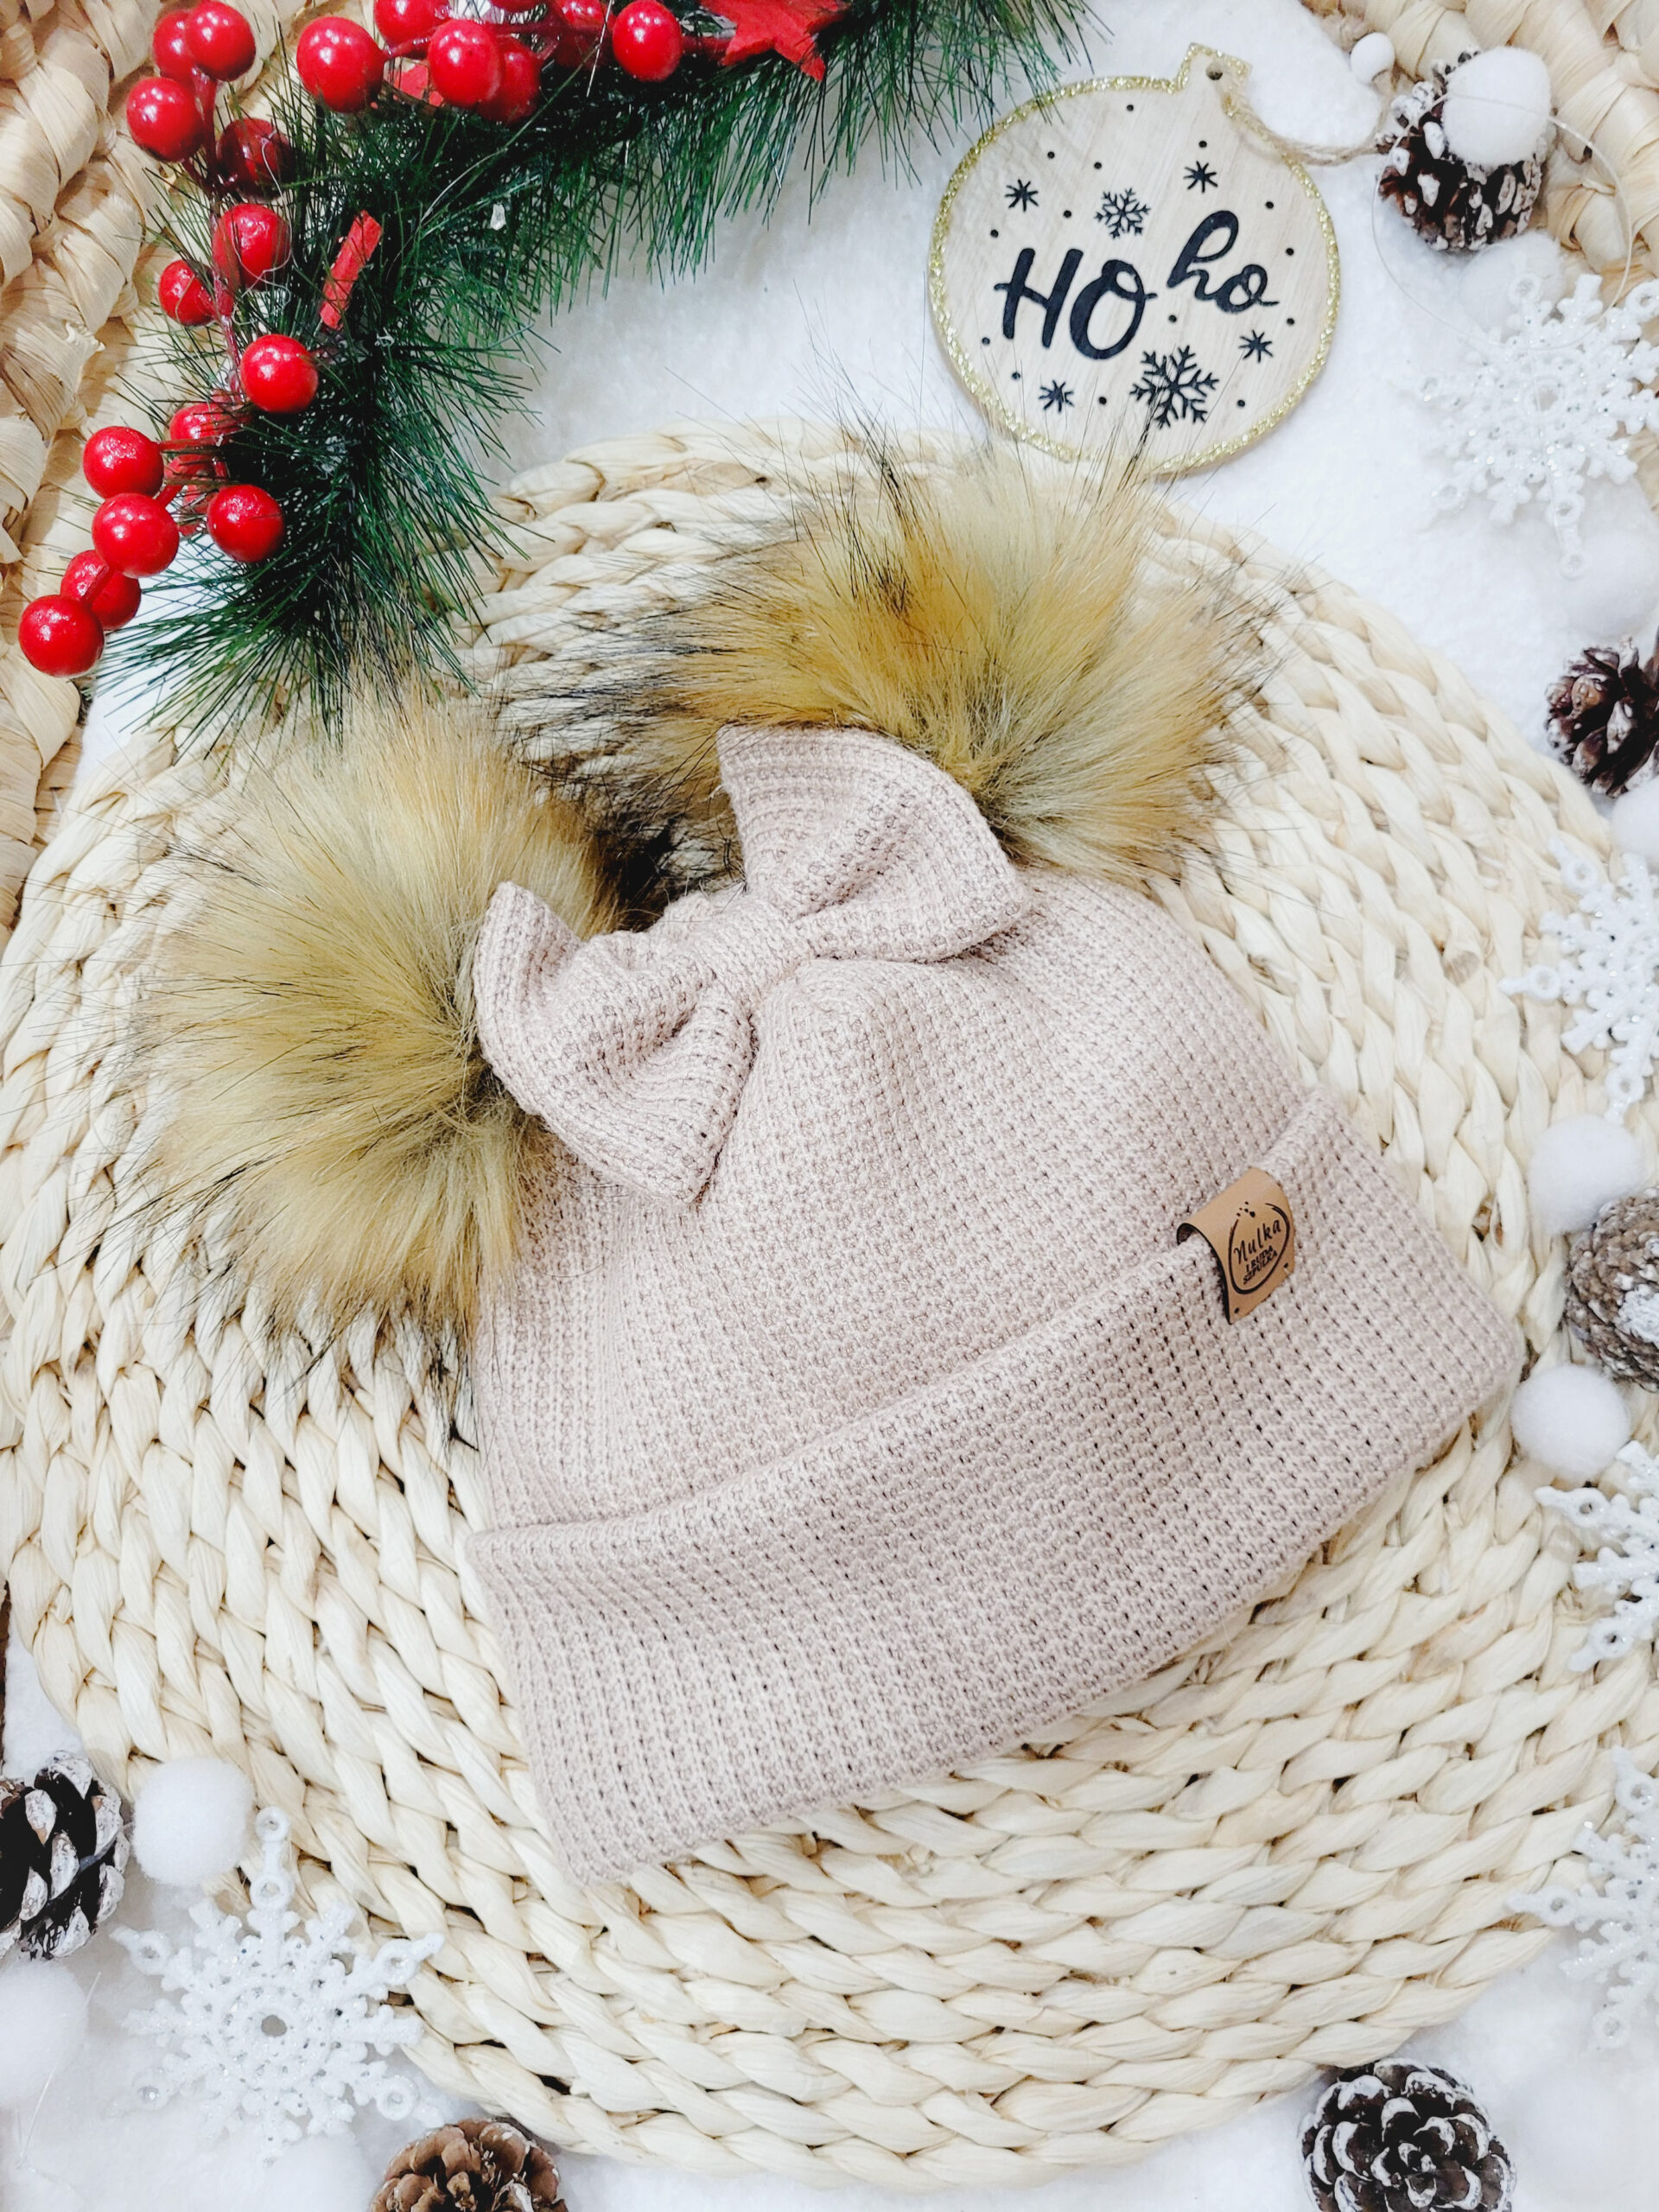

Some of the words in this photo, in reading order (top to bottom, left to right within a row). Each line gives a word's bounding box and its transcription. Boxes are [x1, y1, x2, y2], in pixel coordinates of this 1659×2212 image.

[993, 247, 1158, 360] HO
[1166, 210, 1279, 314] ho
[1234, 1219, 1281, 1265] Nulka
